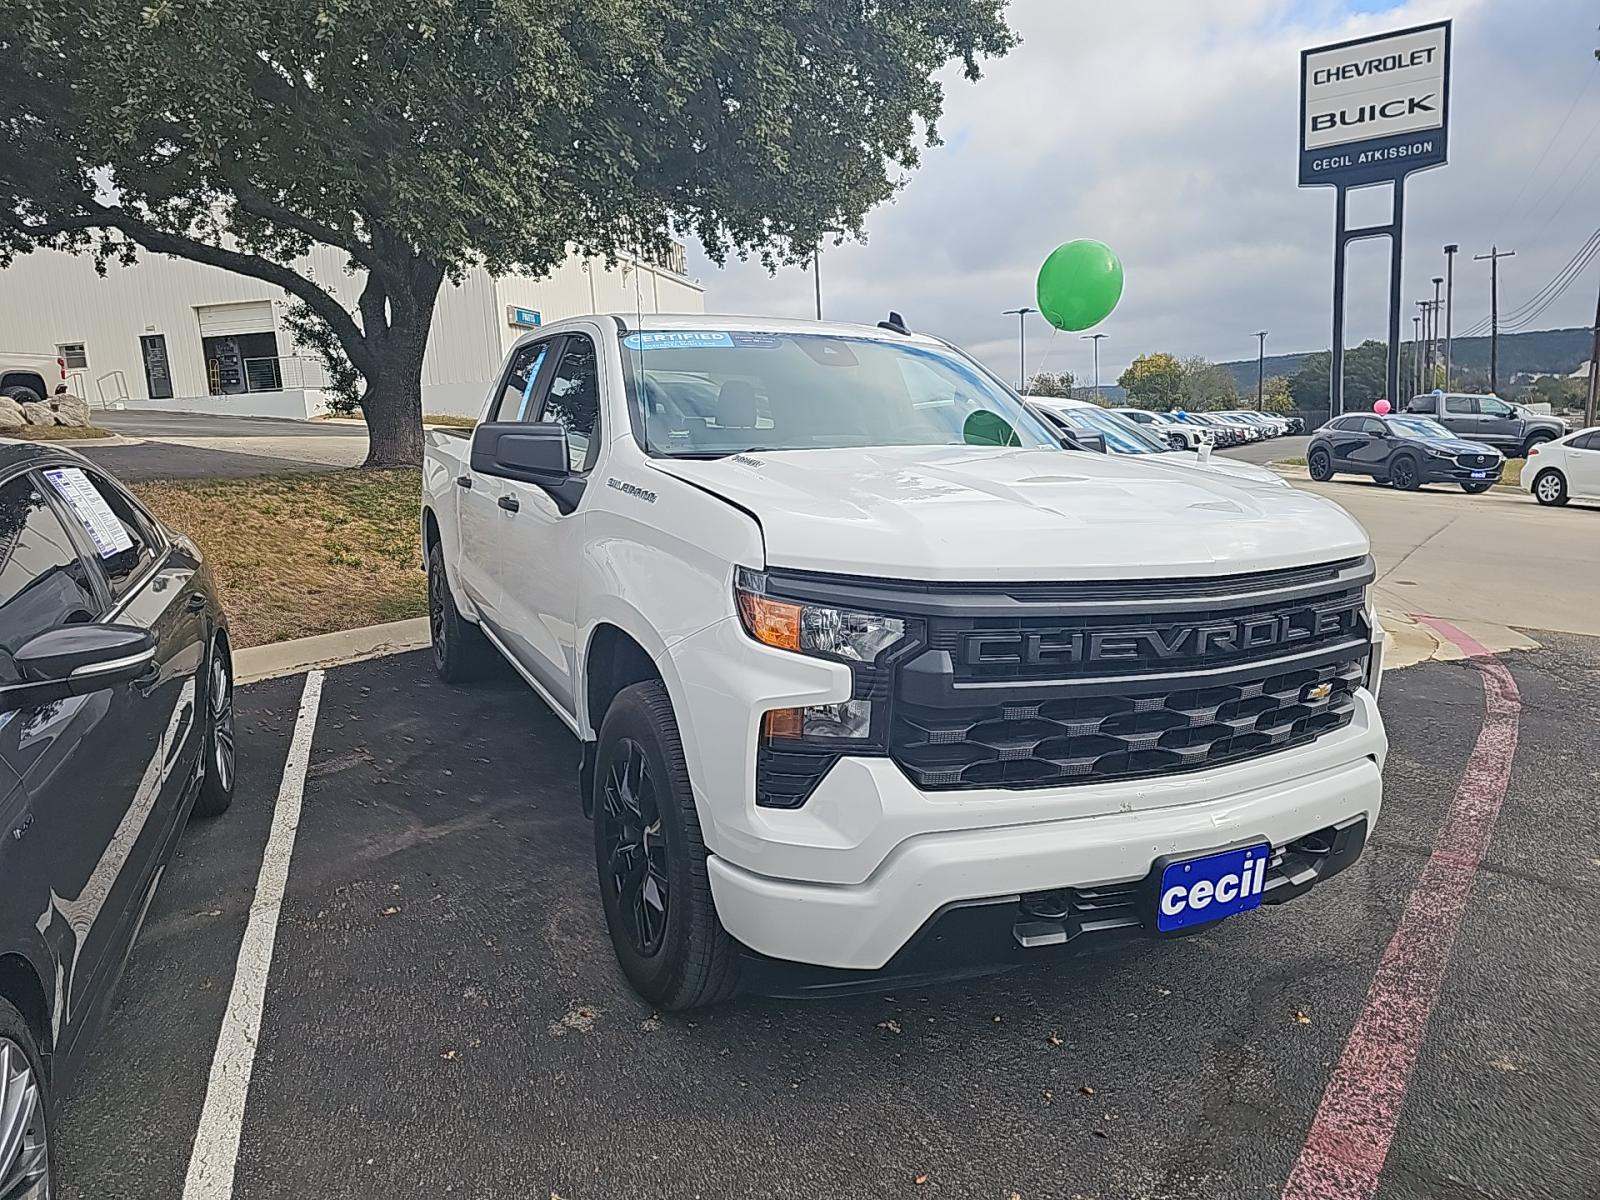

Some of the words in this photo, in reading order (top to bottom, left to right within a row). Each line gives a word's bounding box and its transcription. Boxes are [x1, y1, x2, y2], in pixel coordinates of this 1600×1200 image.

[1313, 46, 1437, 86] CHEVROLET
[1311, 93, 1437, 132] BUICK
[1312, 155, 1353, 171] CECIL
[1358, 141, 1433, 164] ATKISSION
[629, 332, 725, 343] CERTIFIED
[967, 608, 1372, 664] CHEVROLET
[1161, 857, 1267, 916] cecil
